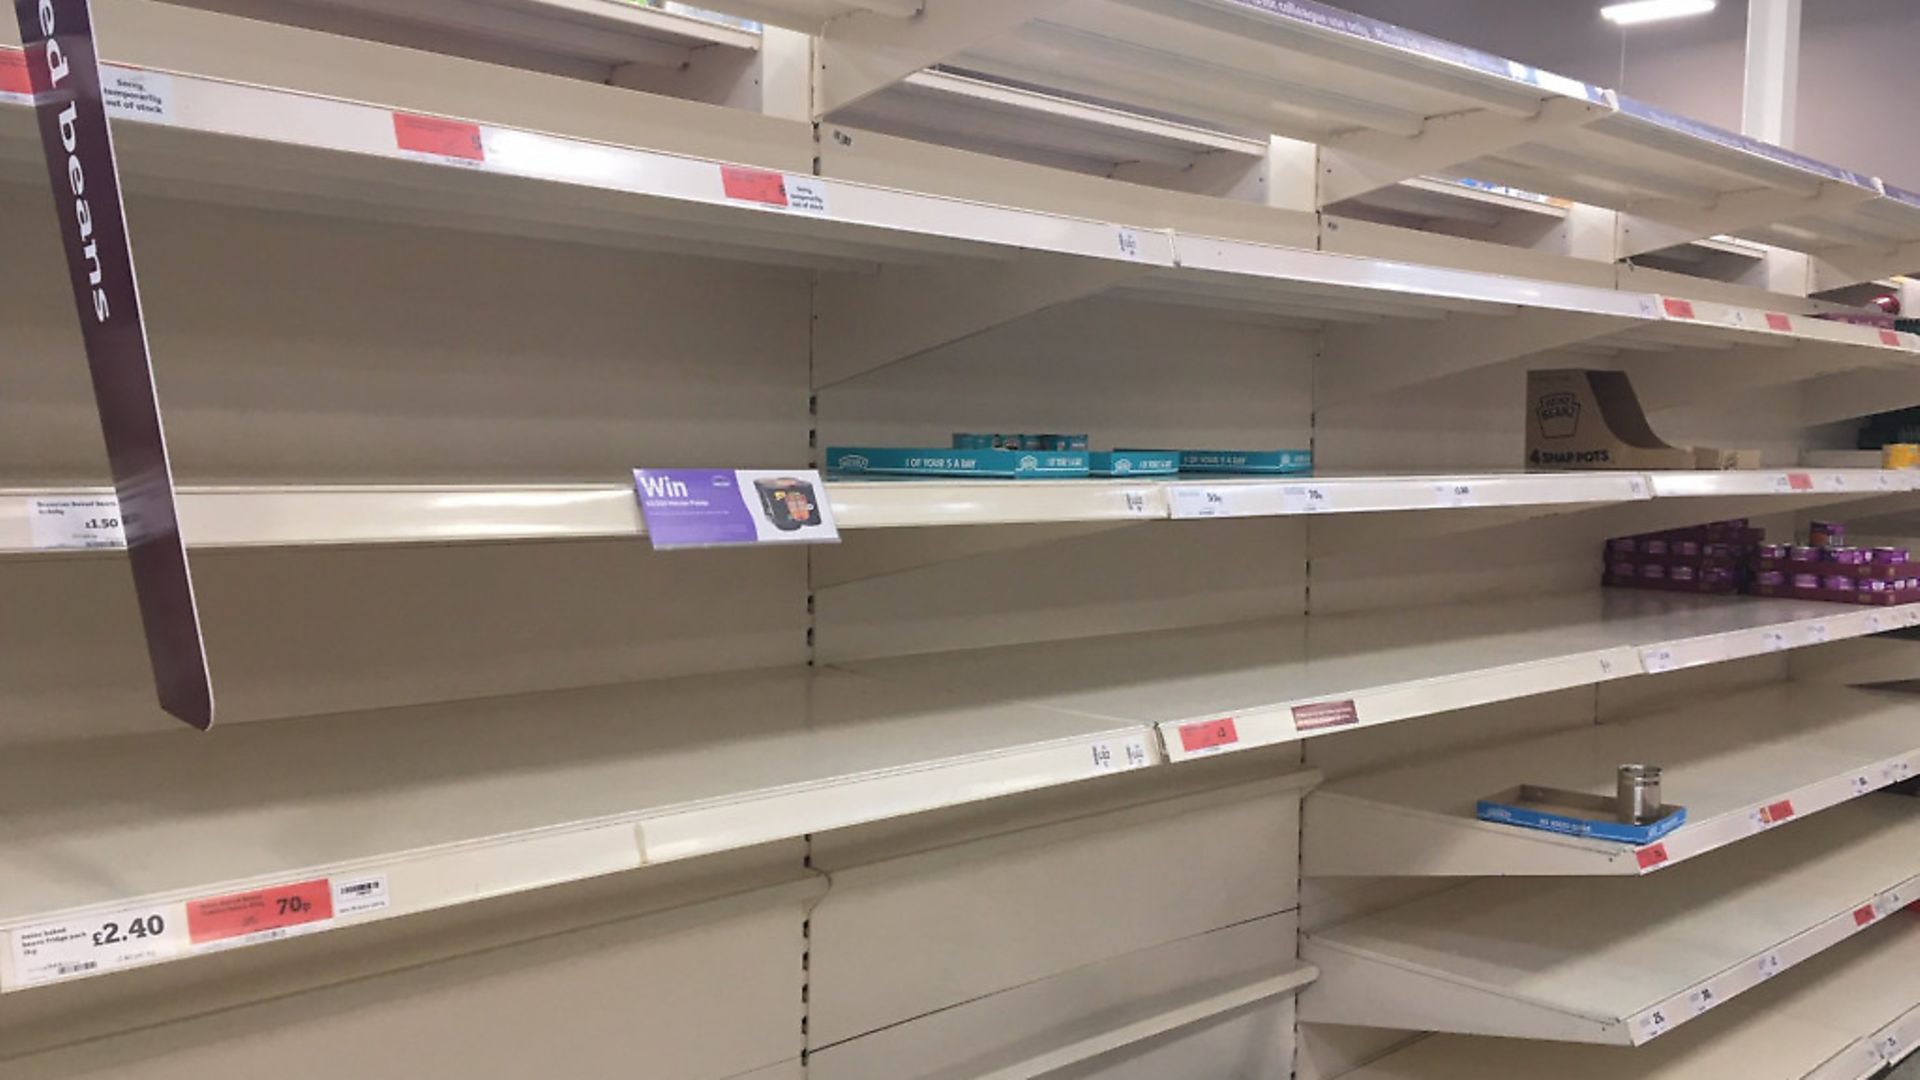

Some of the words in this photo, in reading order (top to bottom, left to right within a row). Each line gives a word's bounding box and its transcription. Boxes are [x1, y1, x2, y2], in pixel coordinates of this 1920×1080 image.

[38, 0, 70, 89] ed
[58, 100, 110, 323] beans
[1530, 448, 1540, 465] 4
[1576, 449, 1609, 463] POTS
[640, 476, 689, 498] Win
[85, 518, 118, 529] £1.50
[277, 895, 312, 916] 70p
[92, 914, 164, 947] £2.40
